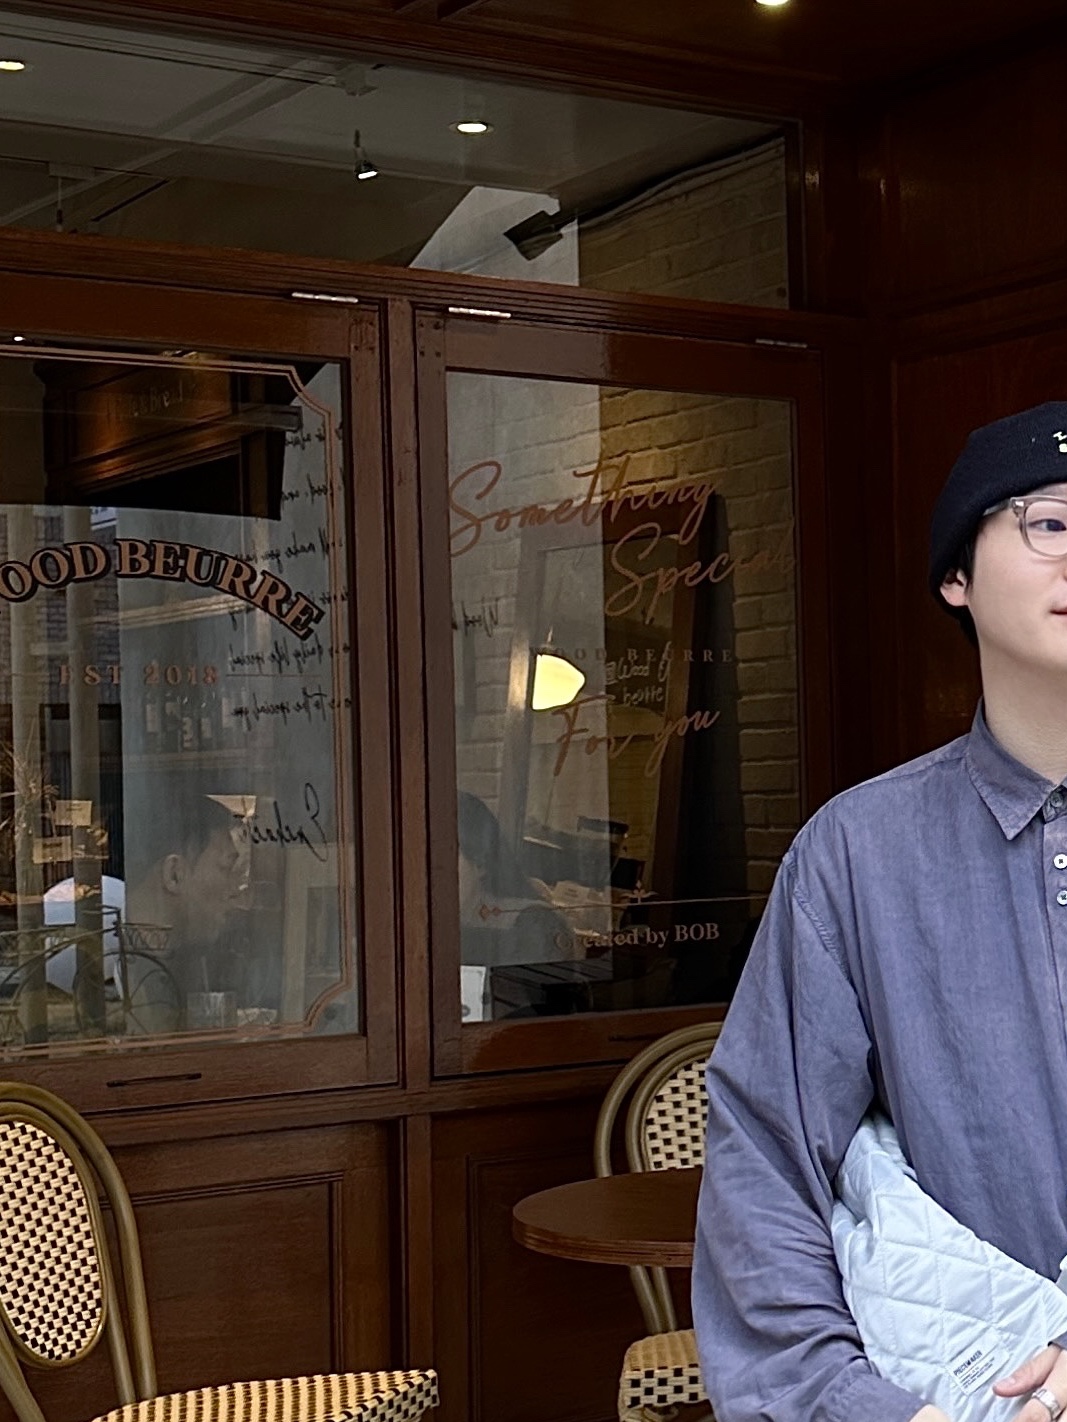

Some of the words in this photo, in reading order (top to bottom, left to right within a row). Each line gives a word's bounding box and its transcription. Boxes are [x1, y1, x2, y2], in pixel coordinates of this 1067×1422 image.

[449, 460, 716, 557] Something
[0, 541, 111, 602] OOD
[115, 538, 326, 641] BEURRE
[645, 709, 721, 778] you
[646, 928, 670, 948] by
[674, 922, 720, 942] BOB
